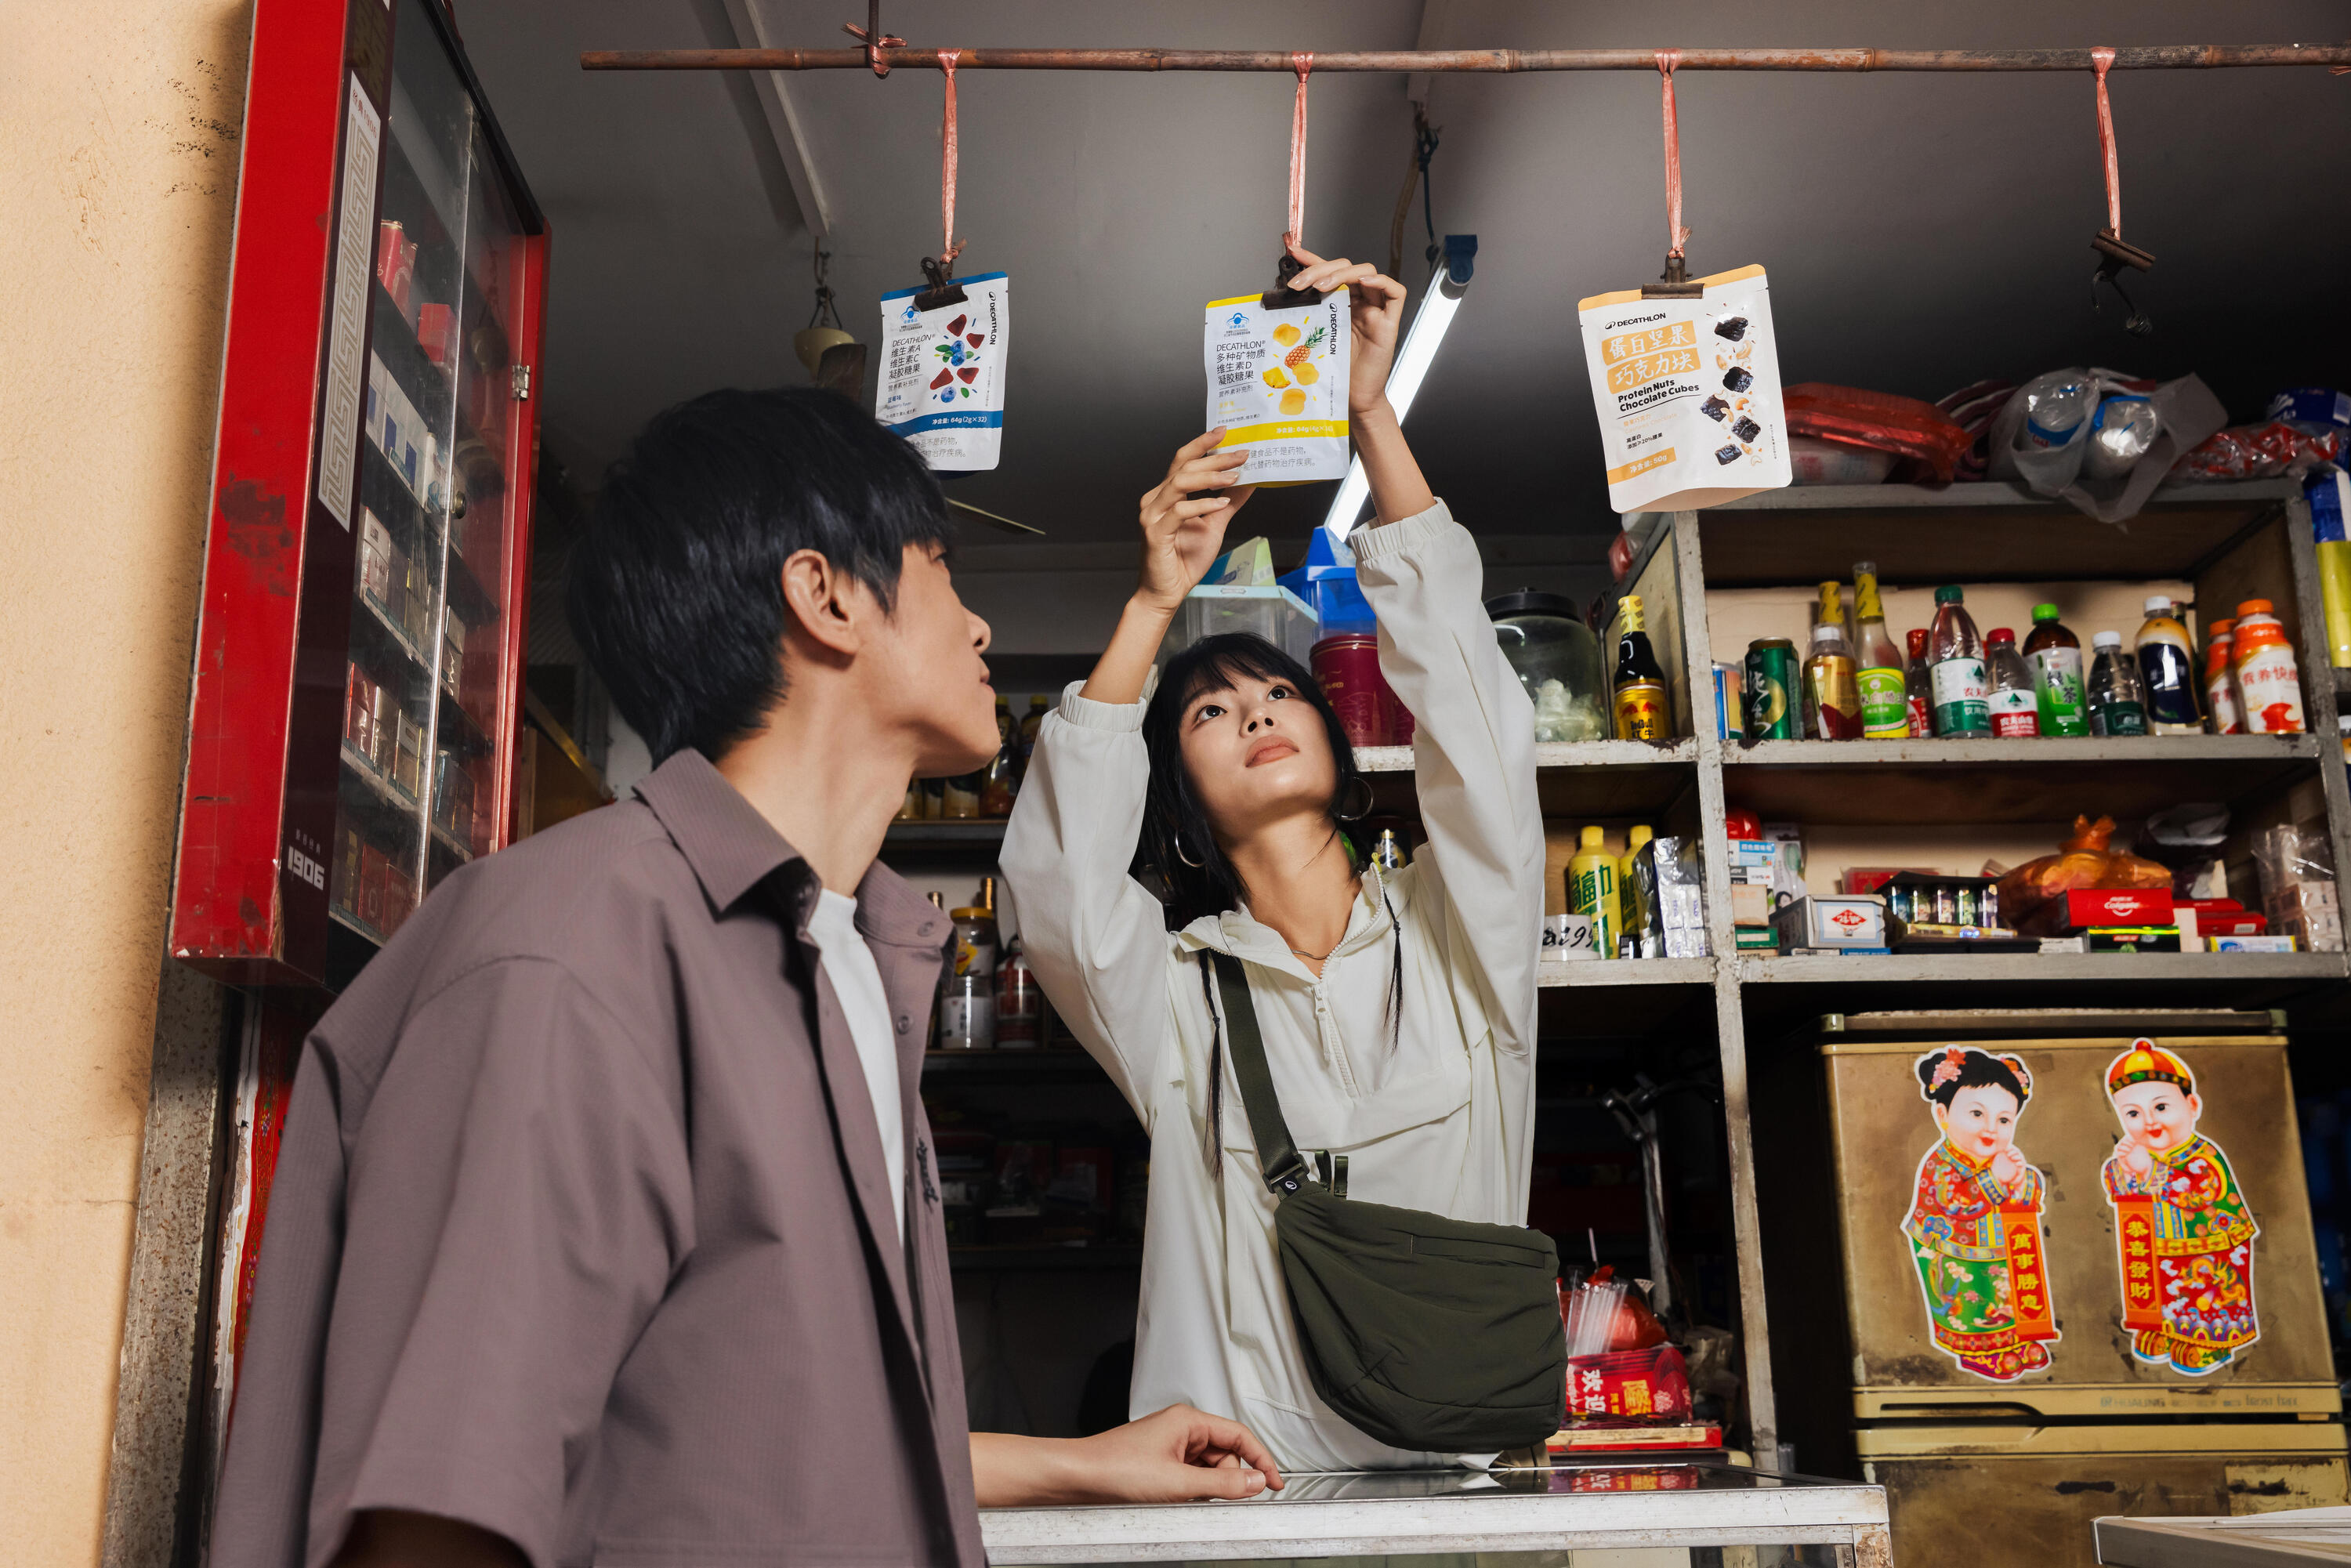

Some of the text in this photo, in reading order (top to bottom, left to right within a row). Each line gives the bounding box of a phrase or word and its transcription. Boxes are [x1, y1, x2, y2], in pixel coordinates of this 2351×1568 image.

[989, 302, 998, 346] DECATHLON
[1617, 313, 1666, 328] DECATHLON
[891, 345, 921, 358] 维生素A
[1610, 325, 1690, 359] 蛋白坚果
[889, 354, 919, 368] 维生素C
[1216, 349, 1266, 364] 多种矿物质
[1216, 361, 1252, 375] 维生素D
[1615, 351, 1694, 386] 巧克力块
[888, 364, 920, 380] 凝胶糖果
[1218, 371, 1254, 386] 凝胶糖果
[1618, 379, 1675, 403] Protein Nuts
[1620, 385, 1699, 411] Chocolate Cubes
[1654, 454, 1668, 464] 50g
[288, 846, 324, 891] 1906
[2125, 1219, 2153, 1300] 恭喜發財
[2011, 1233, 2043, 1311] 萬事勝意
[1581, 1369, 1607, 1413] 欢迎
